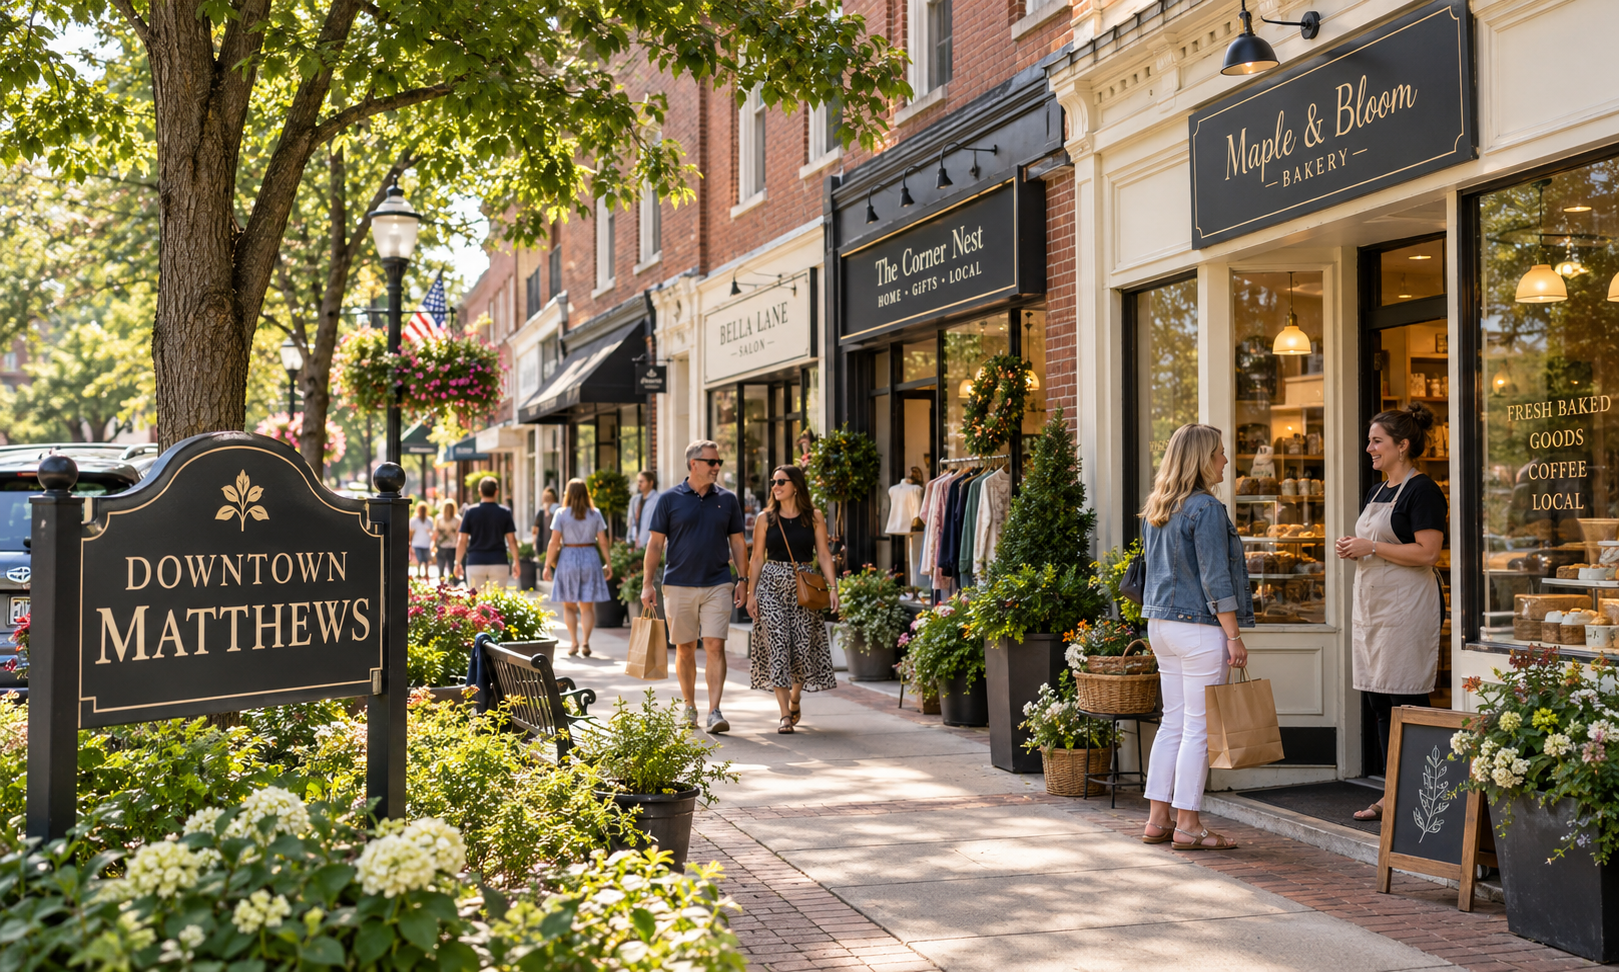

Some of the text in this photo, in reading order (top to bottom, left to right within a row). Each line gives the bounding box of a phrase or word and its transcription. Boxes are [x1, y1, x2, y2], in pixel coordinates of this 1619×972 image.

[1224, 74, 1418, 183] Maple & Bloom
[1282, 148, 1348, 188] BAKERY
[874, 225, 984, 287] The Corner Nest
[877, 288, 902, 308] HOME
[949, 261, 982, 284] LOCAL
[720, 301, 789, 346] BELLA LANE
[738, 338, 766, 358] SALON
[1506, 395, 1611, 421] FRESH BAKED
[1529, 428, 1584, 450] GOODS
[1528, 460, 1588, 480] COFFEE
[1531, 492, 1585, 511] LOCAL
[125, 551, 348, 591] DOWNTOWN
[95, 597, 371, 665] MATTHEWS
